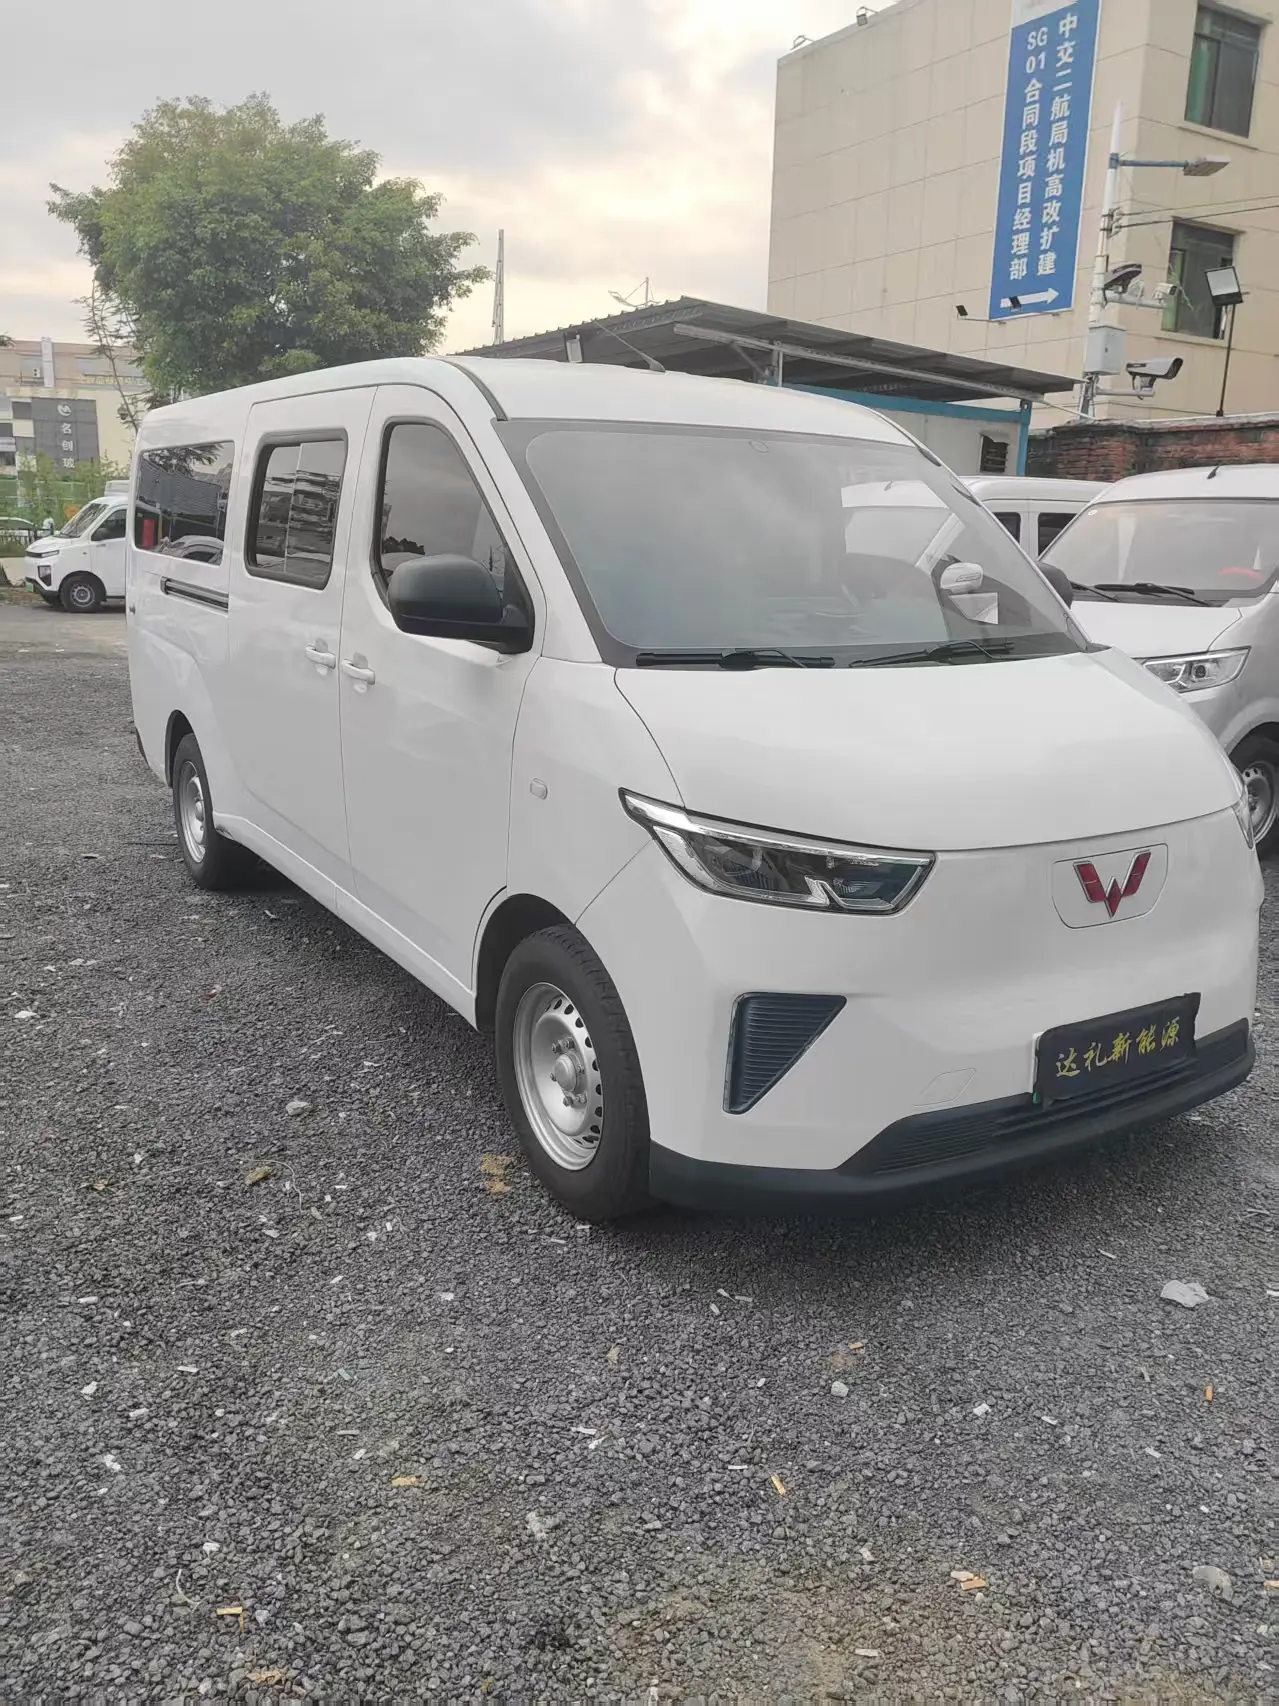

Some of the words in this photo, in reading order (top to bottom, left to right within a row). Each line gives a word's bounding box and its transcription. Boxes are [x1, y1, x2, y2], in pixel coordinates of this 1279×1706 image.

[1037, 13, 1078, 277] 中交二航局机高改扩建
[1056, 1016, 1180, 1077] 达礼新能源
